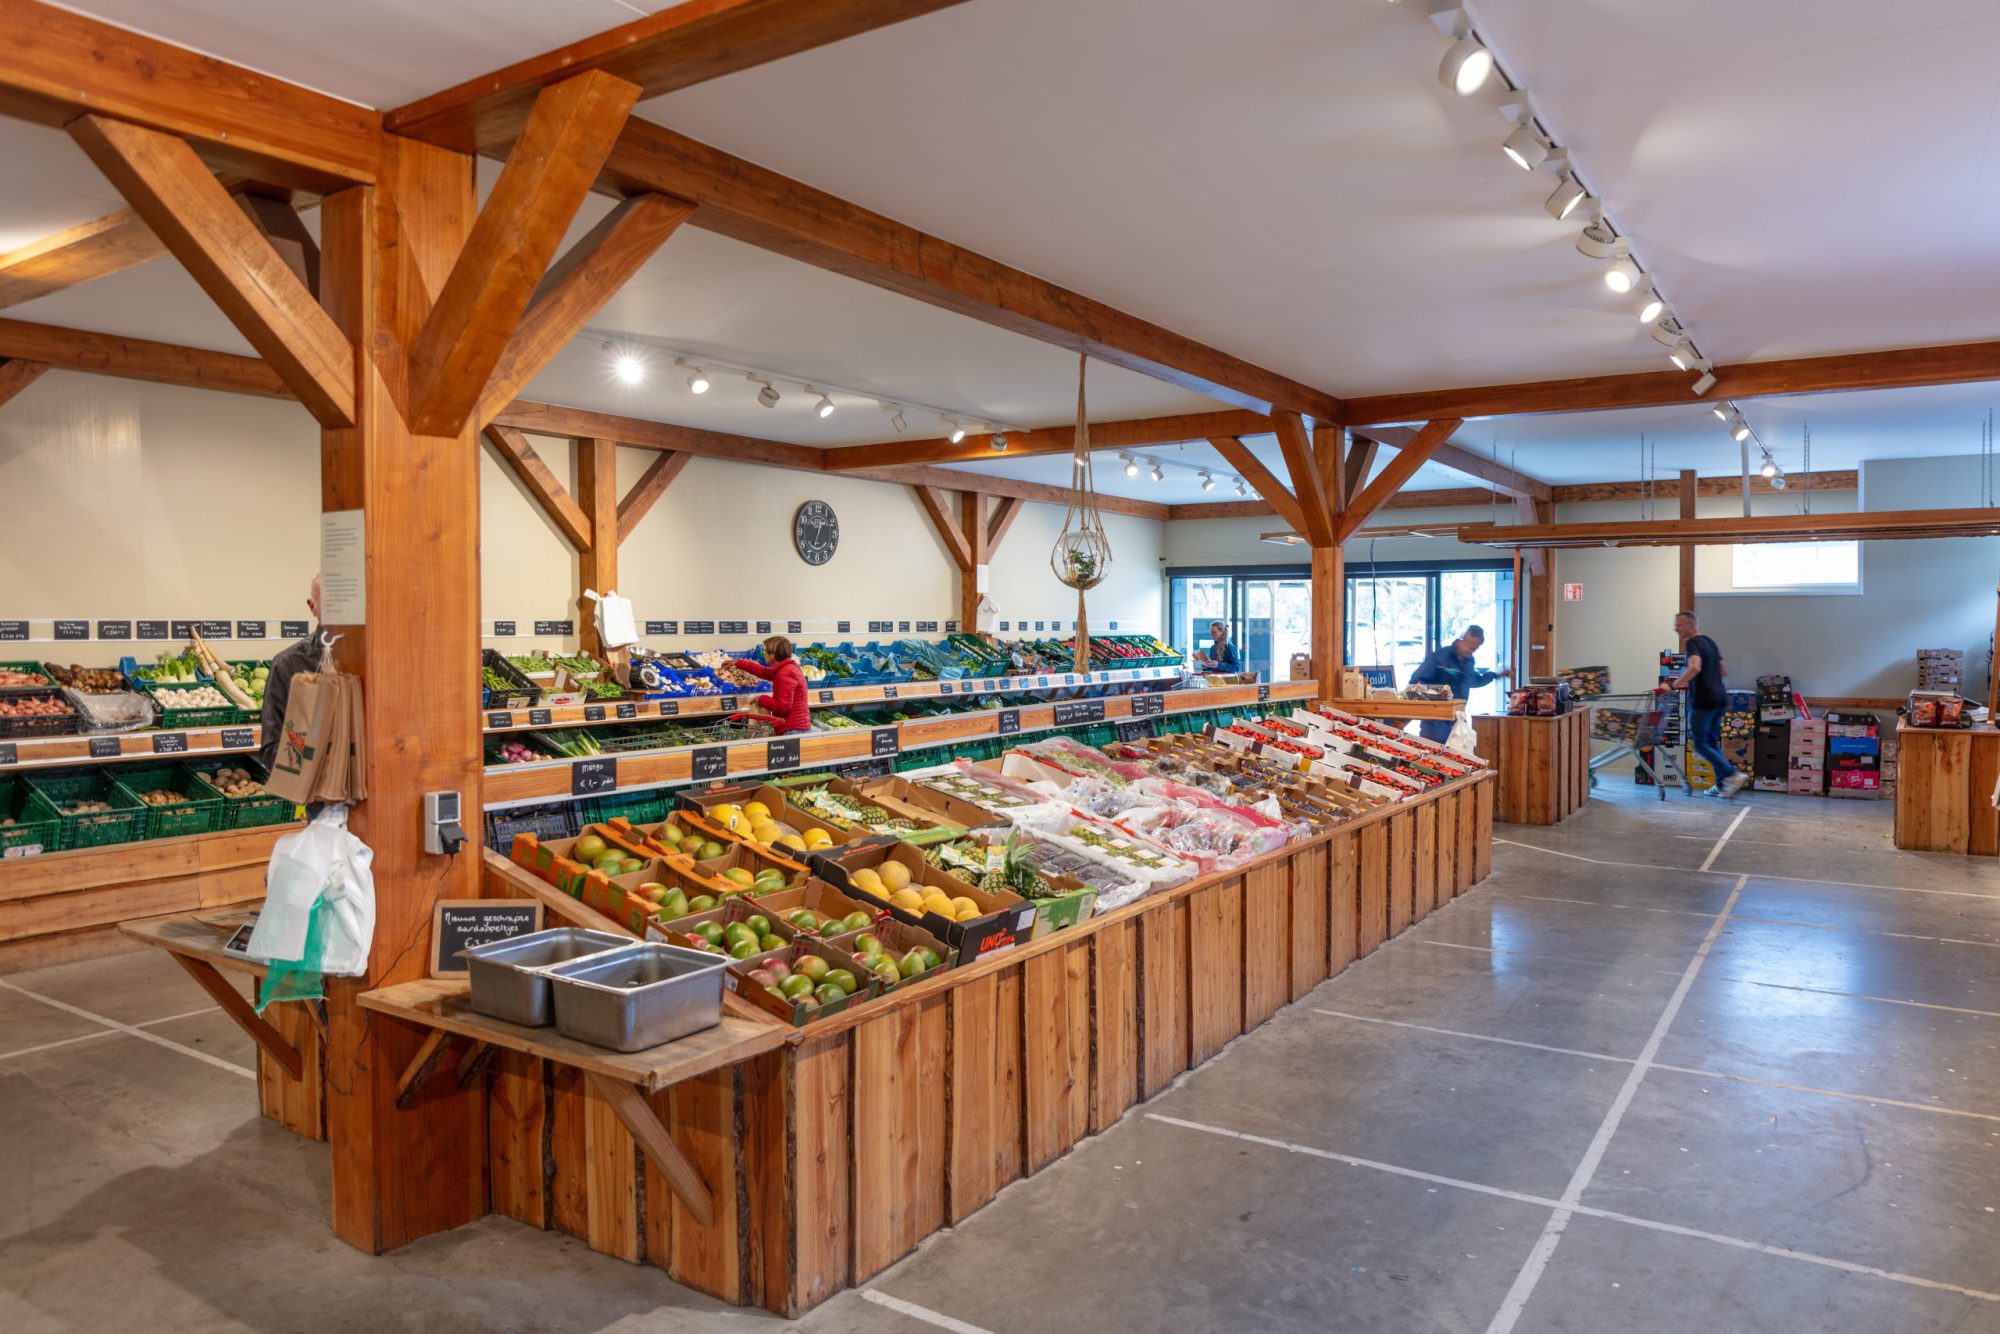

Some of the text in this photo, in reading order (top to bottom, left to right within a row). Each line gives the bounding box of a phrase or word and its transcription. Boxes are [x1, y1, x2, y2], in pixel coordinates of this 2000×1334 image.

[445, 911, 530, 927] Nieuwe geschrapte
[457, 925, 519, 936] aardappeltjes
